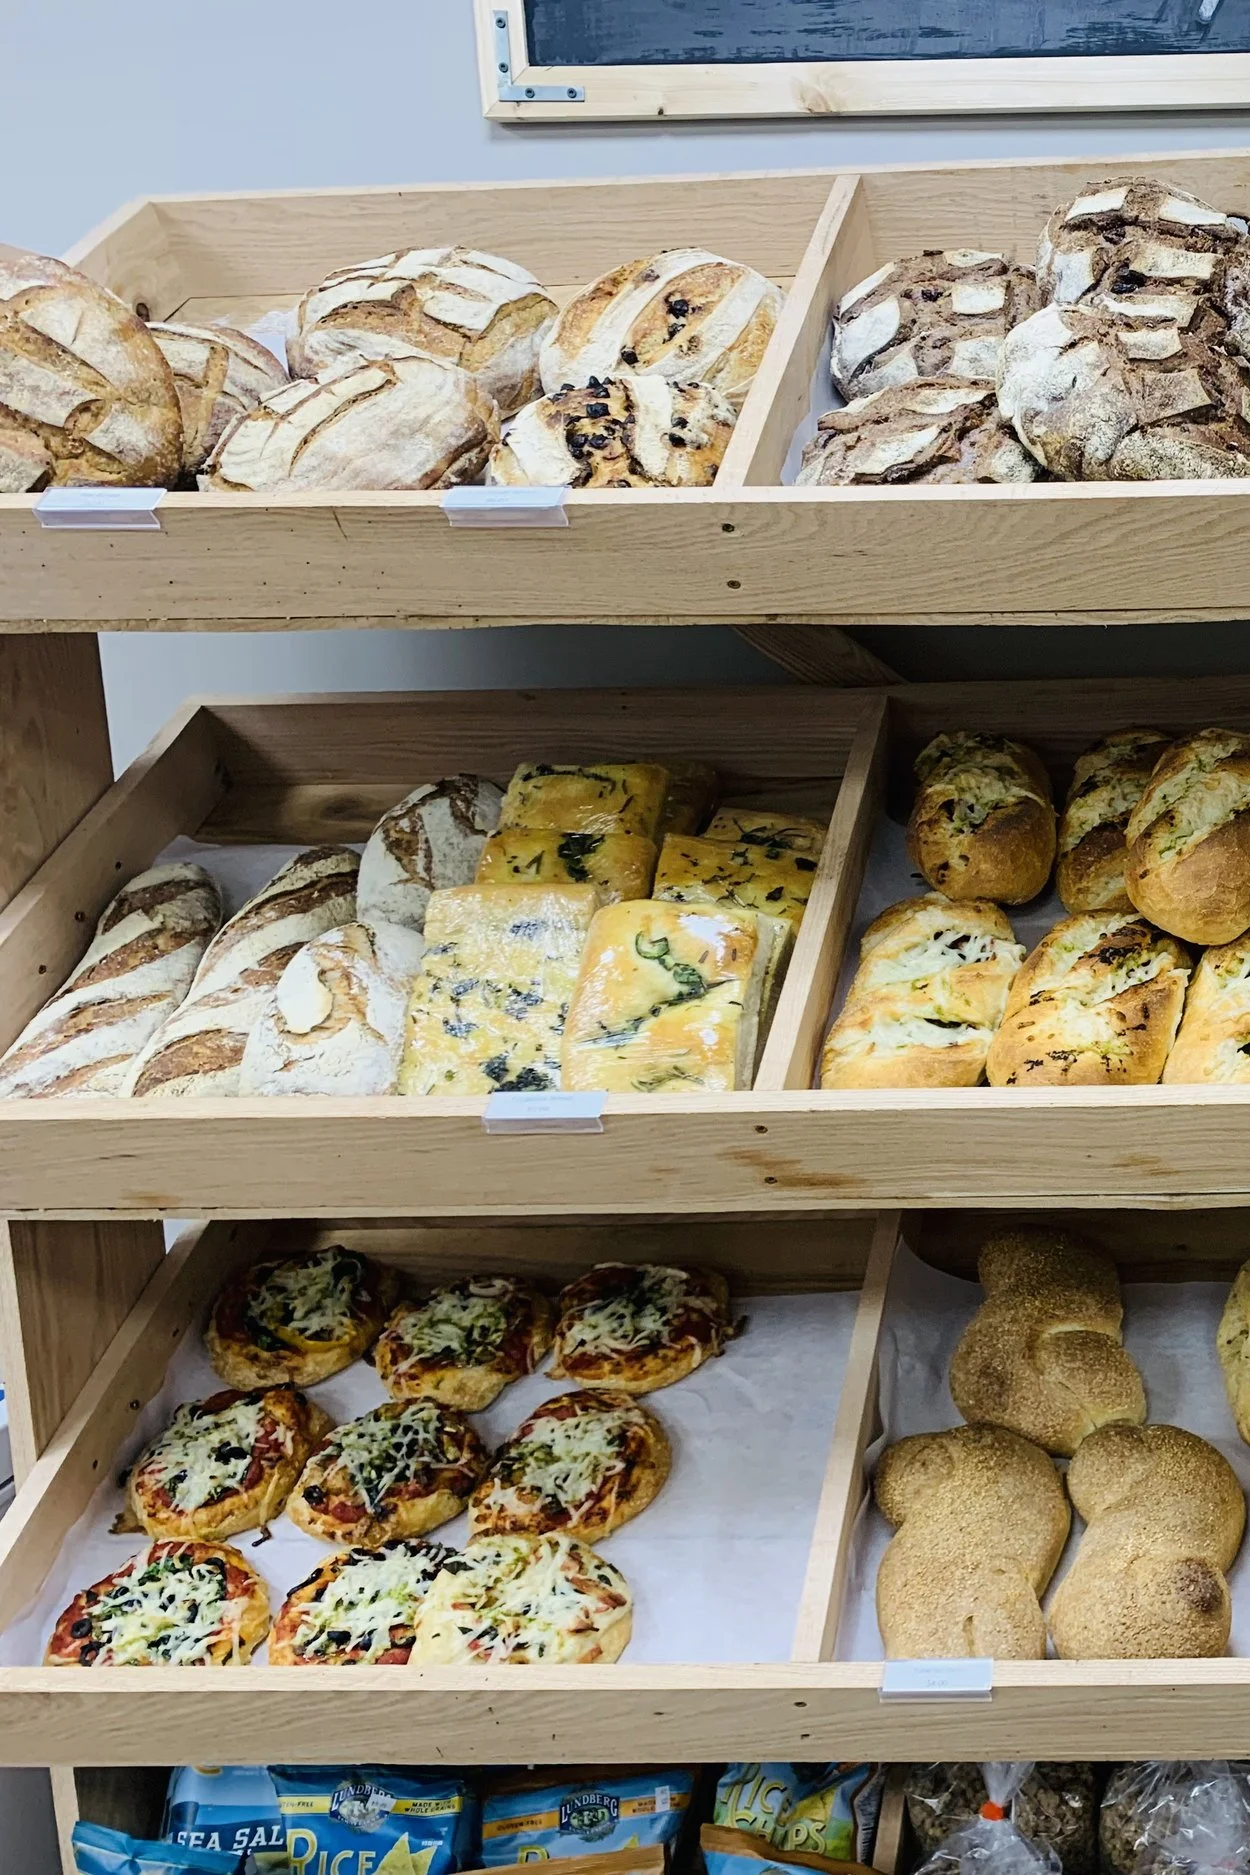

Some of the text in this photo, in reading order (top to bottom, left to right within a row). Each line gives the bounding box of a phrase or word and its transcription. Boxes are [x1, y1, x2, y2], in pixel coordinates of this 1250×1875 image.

[561, 1793, 618, 1824] LUNDBERG
[177, 1825, 284, 1852] SEA SAL
[287, 1828, 376, 1875] RICE
